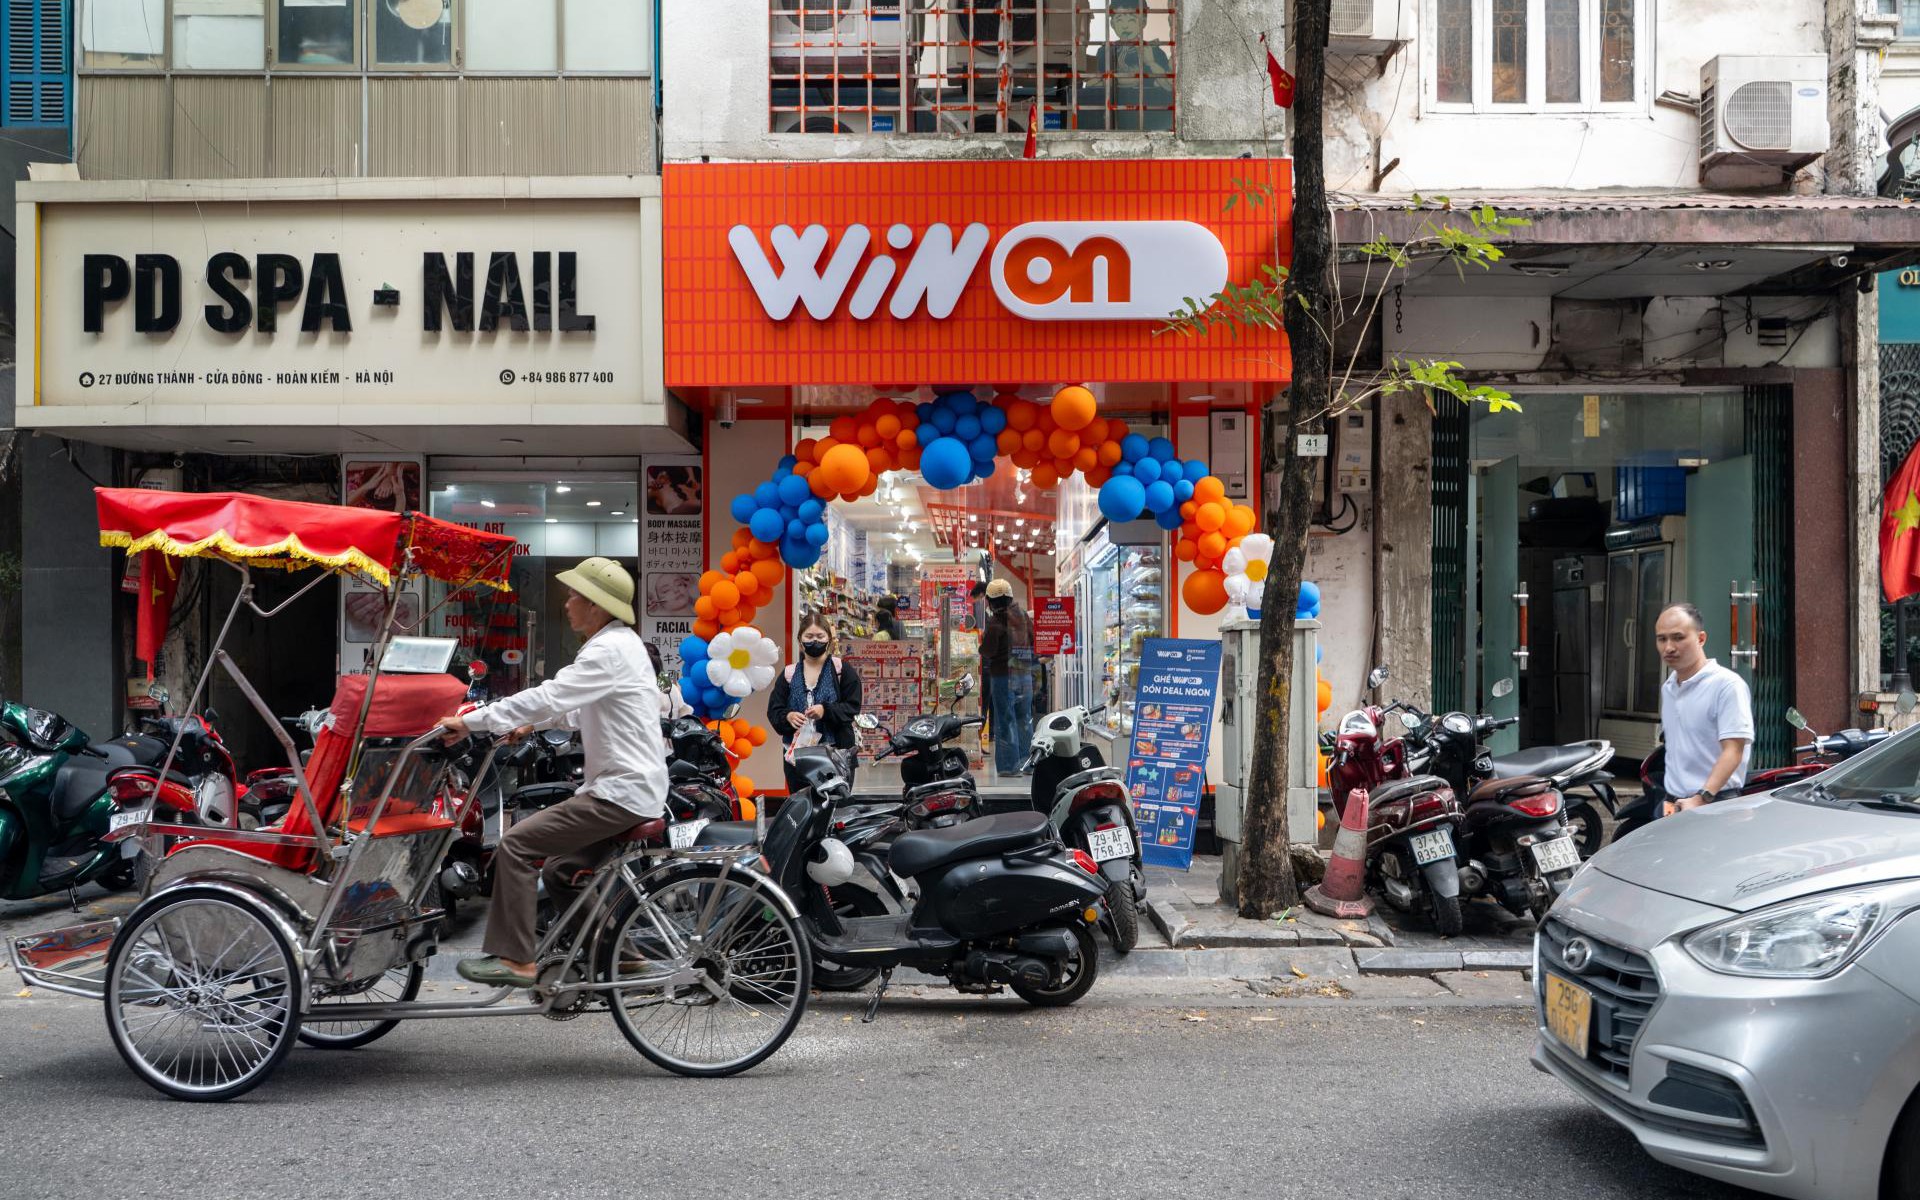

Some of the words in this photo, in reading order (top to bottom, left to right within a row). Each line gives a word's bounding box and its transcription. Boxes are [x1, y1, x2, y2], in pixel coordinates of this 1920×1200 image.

[1003, 235, 1131, 303] on
[83, 253, 181, 333] PD
[205, 252, 351, 333] SPA
[423, 251, 595, 332] NAIL
[98, 374, 112, 385] 27
[115, 370, 154, 384] ĐƯỜNG
[158, 370, 194, 384] THÀNH
[206, 368, 229, 384] CỬA
[232, 370, 263, 384] ĐÔNG
[276, 370, 307, 384] HOÀN
[355, 370, 370, 383] HÀ
[373, 370, 394, 386] NỘI
[520, 372, 542, 382] +84
[545, 372, 566, 382] 986
[569, 372, 590, 382] 877
[593, 372, 614, 382] 400
[1306, 438, 1318, 447] 41
[484, 522, 505, 534] ART
[648, 520, 666, 528] BODY
[667, 520, 701, 528] MASSAGE
[648, 531, 702, 544] 身体按摩
[648, 547, 667, 556] 바디
[671, 547, 700, 556] 마사지
[656, 622, 691, 633] FACIAL
[1154, 674, 1171, 683] GHÉ
[1163, 687, 1183, 695] DEAL
[1185, 688, 1210, 696] NGON
[1094, 830, 1122, 846] 29-AF
[1416, 831, 1445, 849] 37-K1
[1094, 842, 1130, 859] 758.33
[1417, 843, 1453, 862] 835.90
